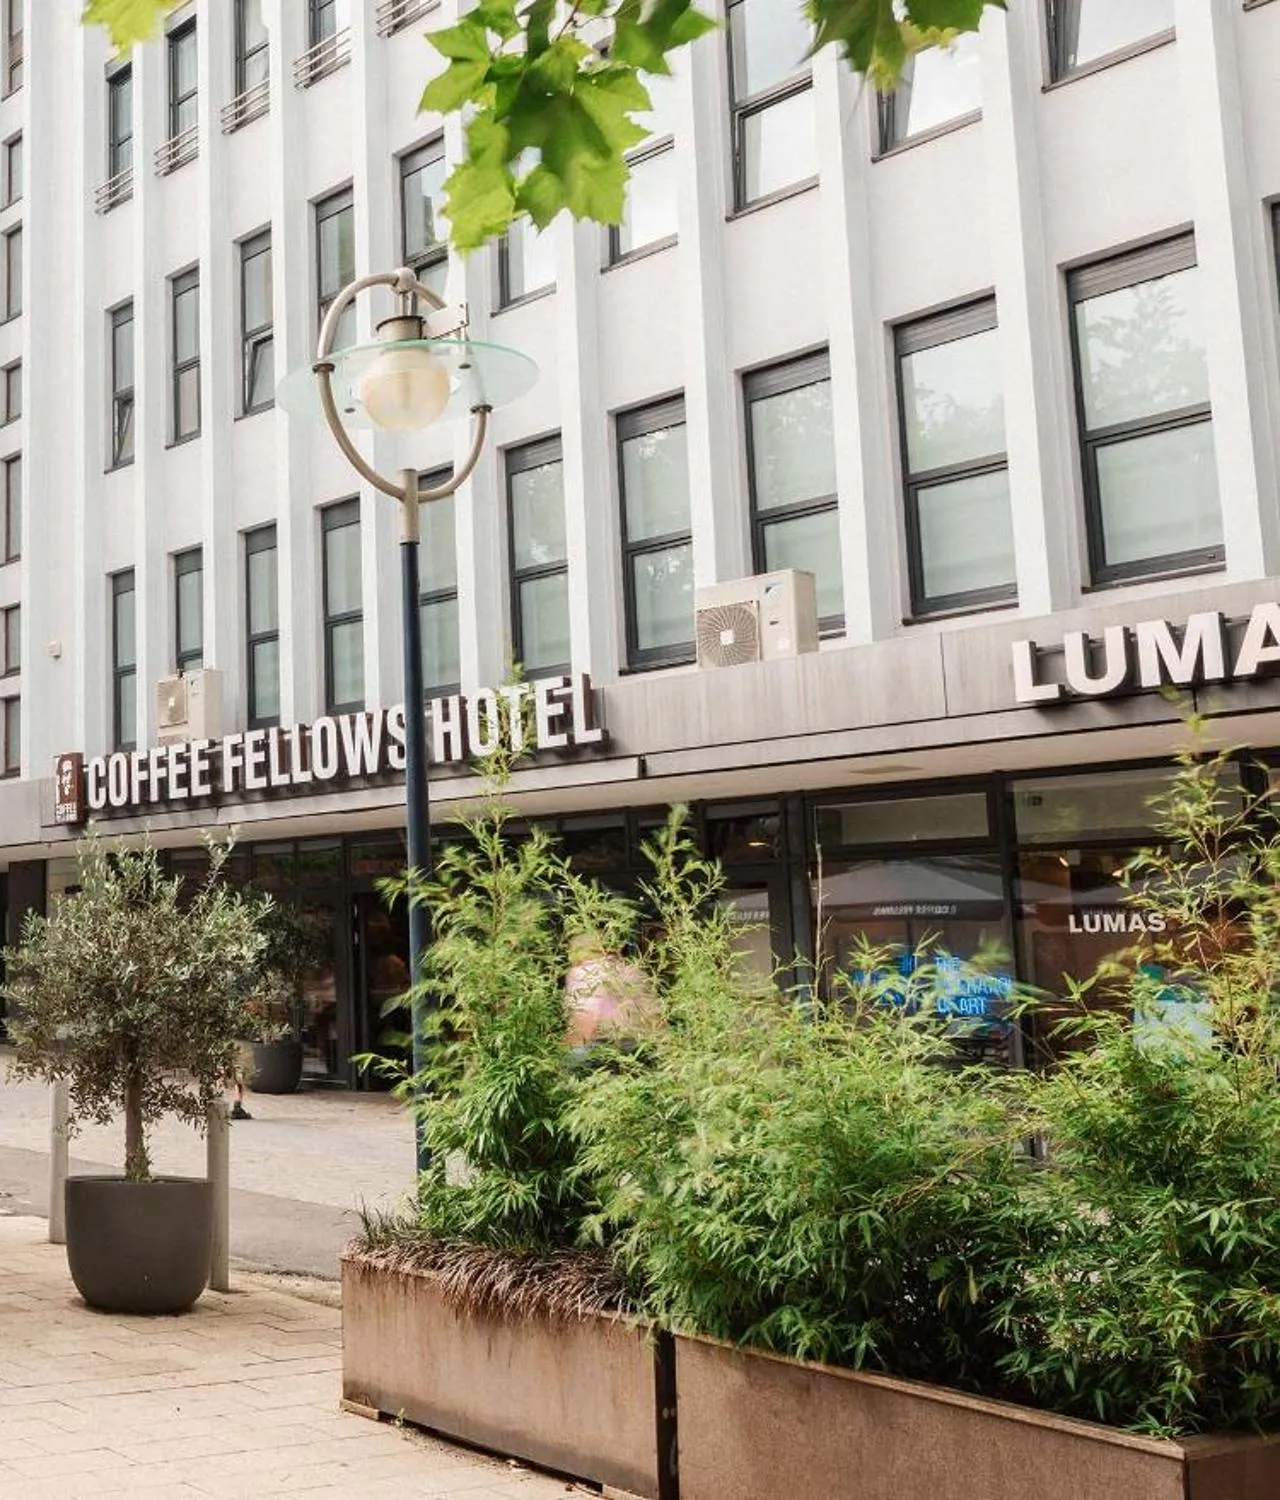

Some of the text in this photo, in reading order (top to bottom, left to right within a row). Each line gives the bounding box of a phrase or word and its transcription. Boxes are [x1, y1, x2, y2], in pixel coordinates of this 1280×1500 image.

[1012, 602, 1280, 702] LUMA
[88, 672, 603, 809] COFFEE FELLOWS HOTEL
[1069, 912, 1167, 933] LUMAS
